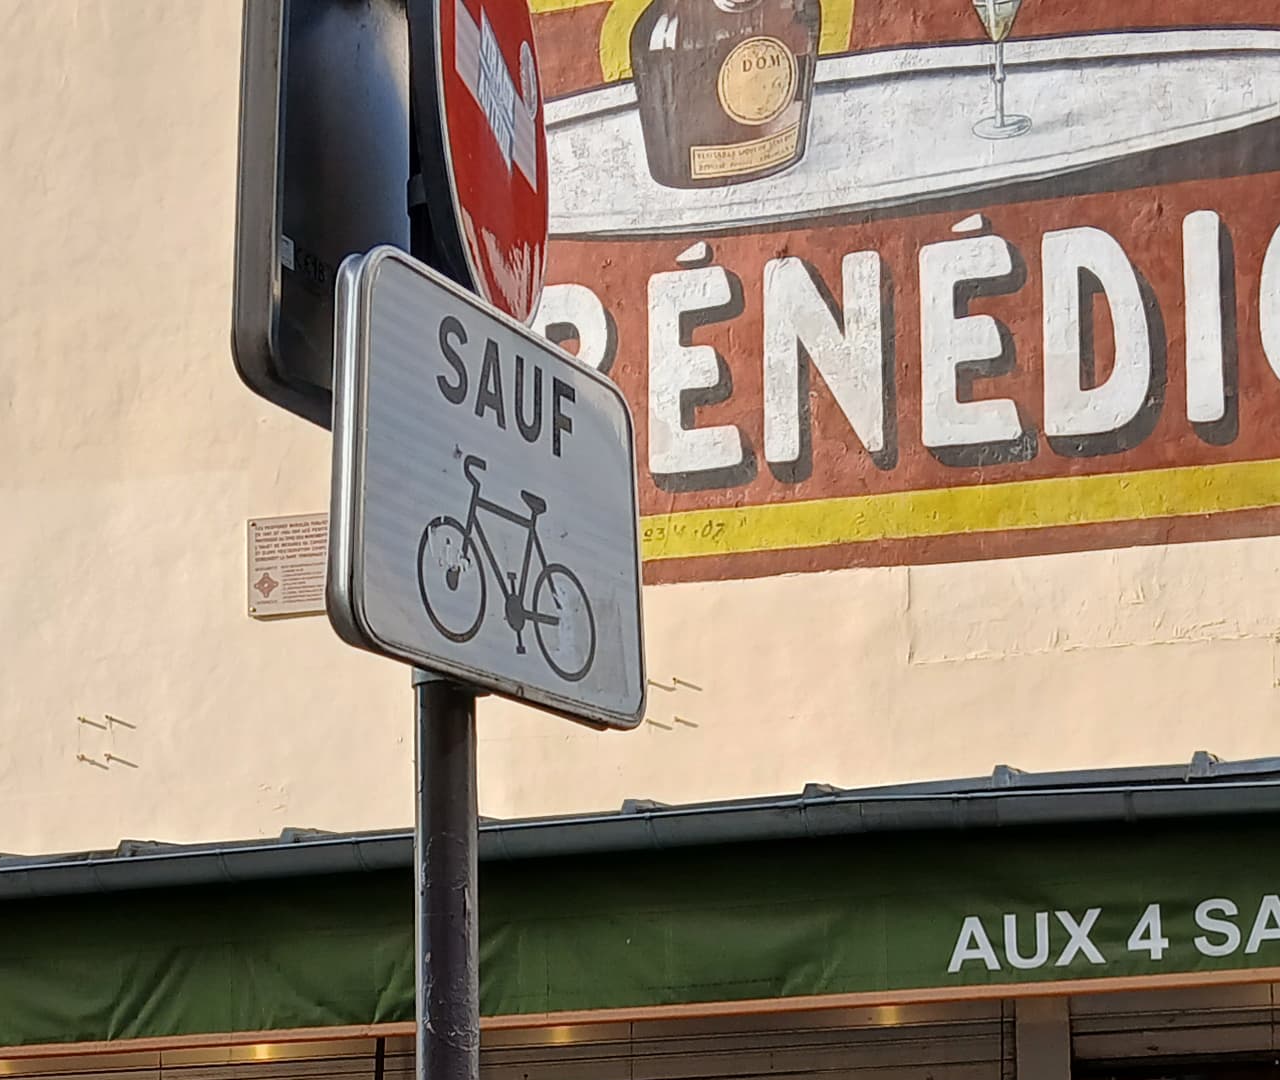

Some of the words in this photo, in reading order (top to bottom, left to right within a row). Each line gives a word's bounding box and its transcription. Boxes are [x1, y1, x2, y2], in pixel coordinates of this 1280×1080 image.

[742, 54, 781, 72] DOM
[437, 315, 576, 457] SAUF
[948, 907, 1105, 973] AUX
[1127, 904, 1169, 960] 4
